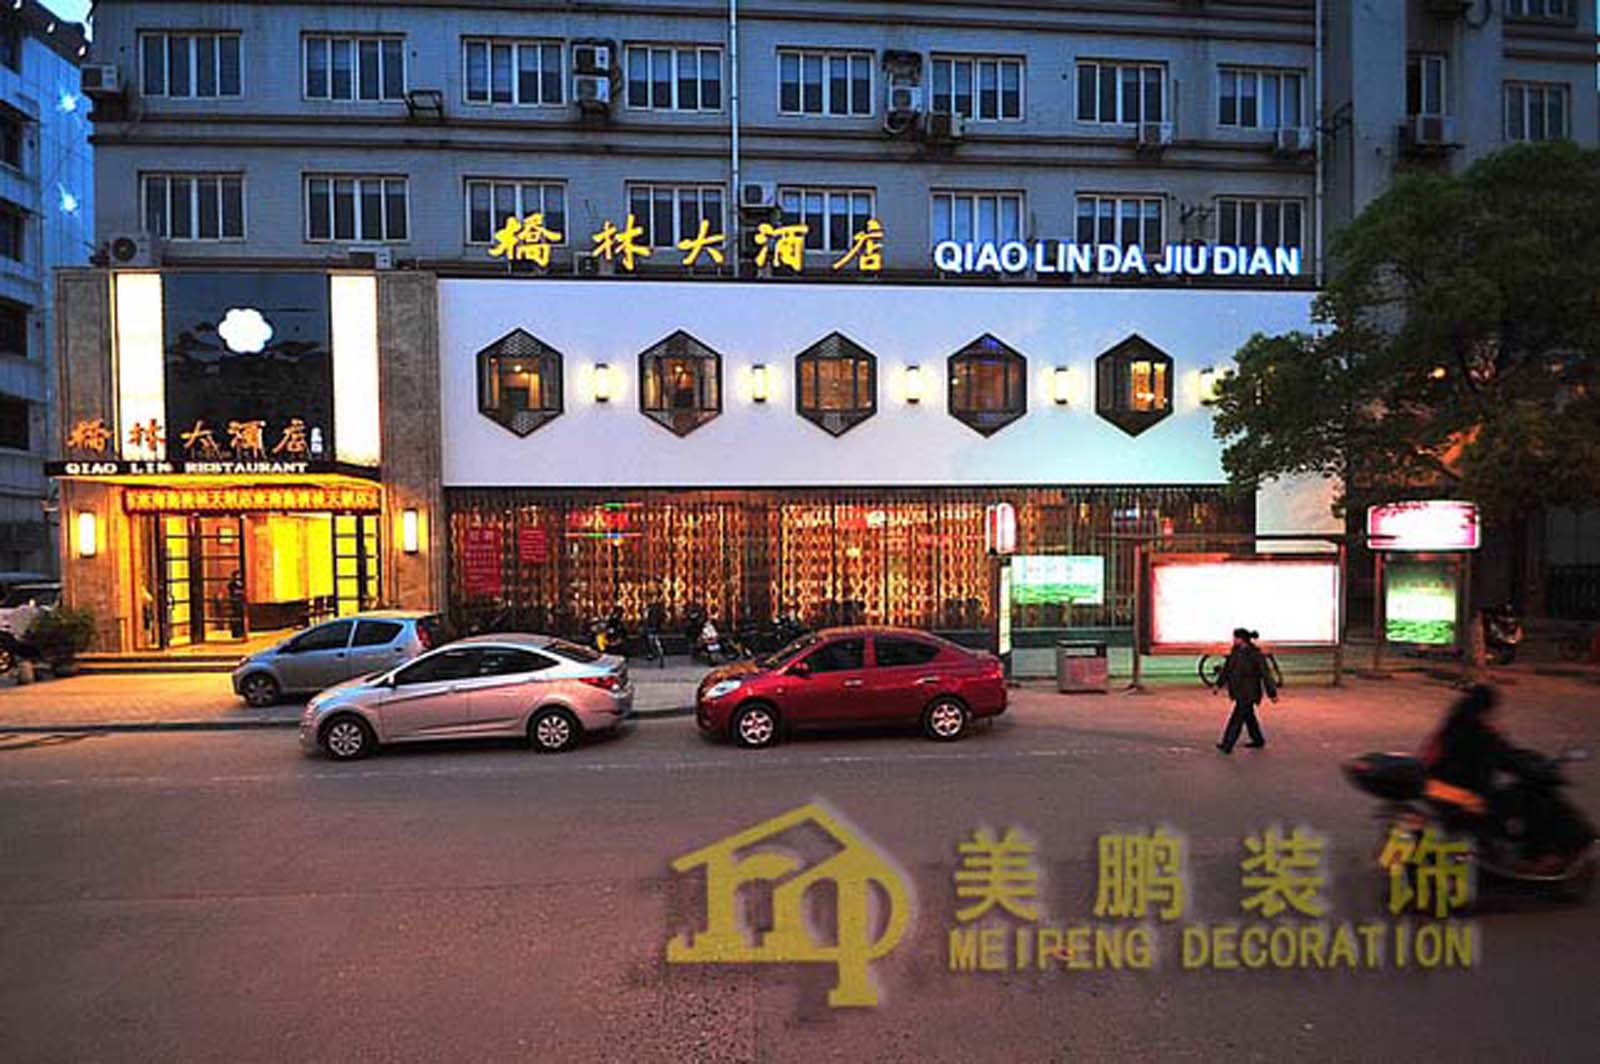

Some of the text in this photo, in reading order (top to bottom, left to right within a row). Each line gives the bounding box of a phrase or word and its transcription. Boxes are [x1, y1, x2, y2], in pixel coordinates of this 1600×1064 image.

[934, 241, 1300, 276] QIAO LIN DA JIU DIAN
[65, 462, 118, 475] QIAO
[185, 462, 308, 474] RESTAURANT
